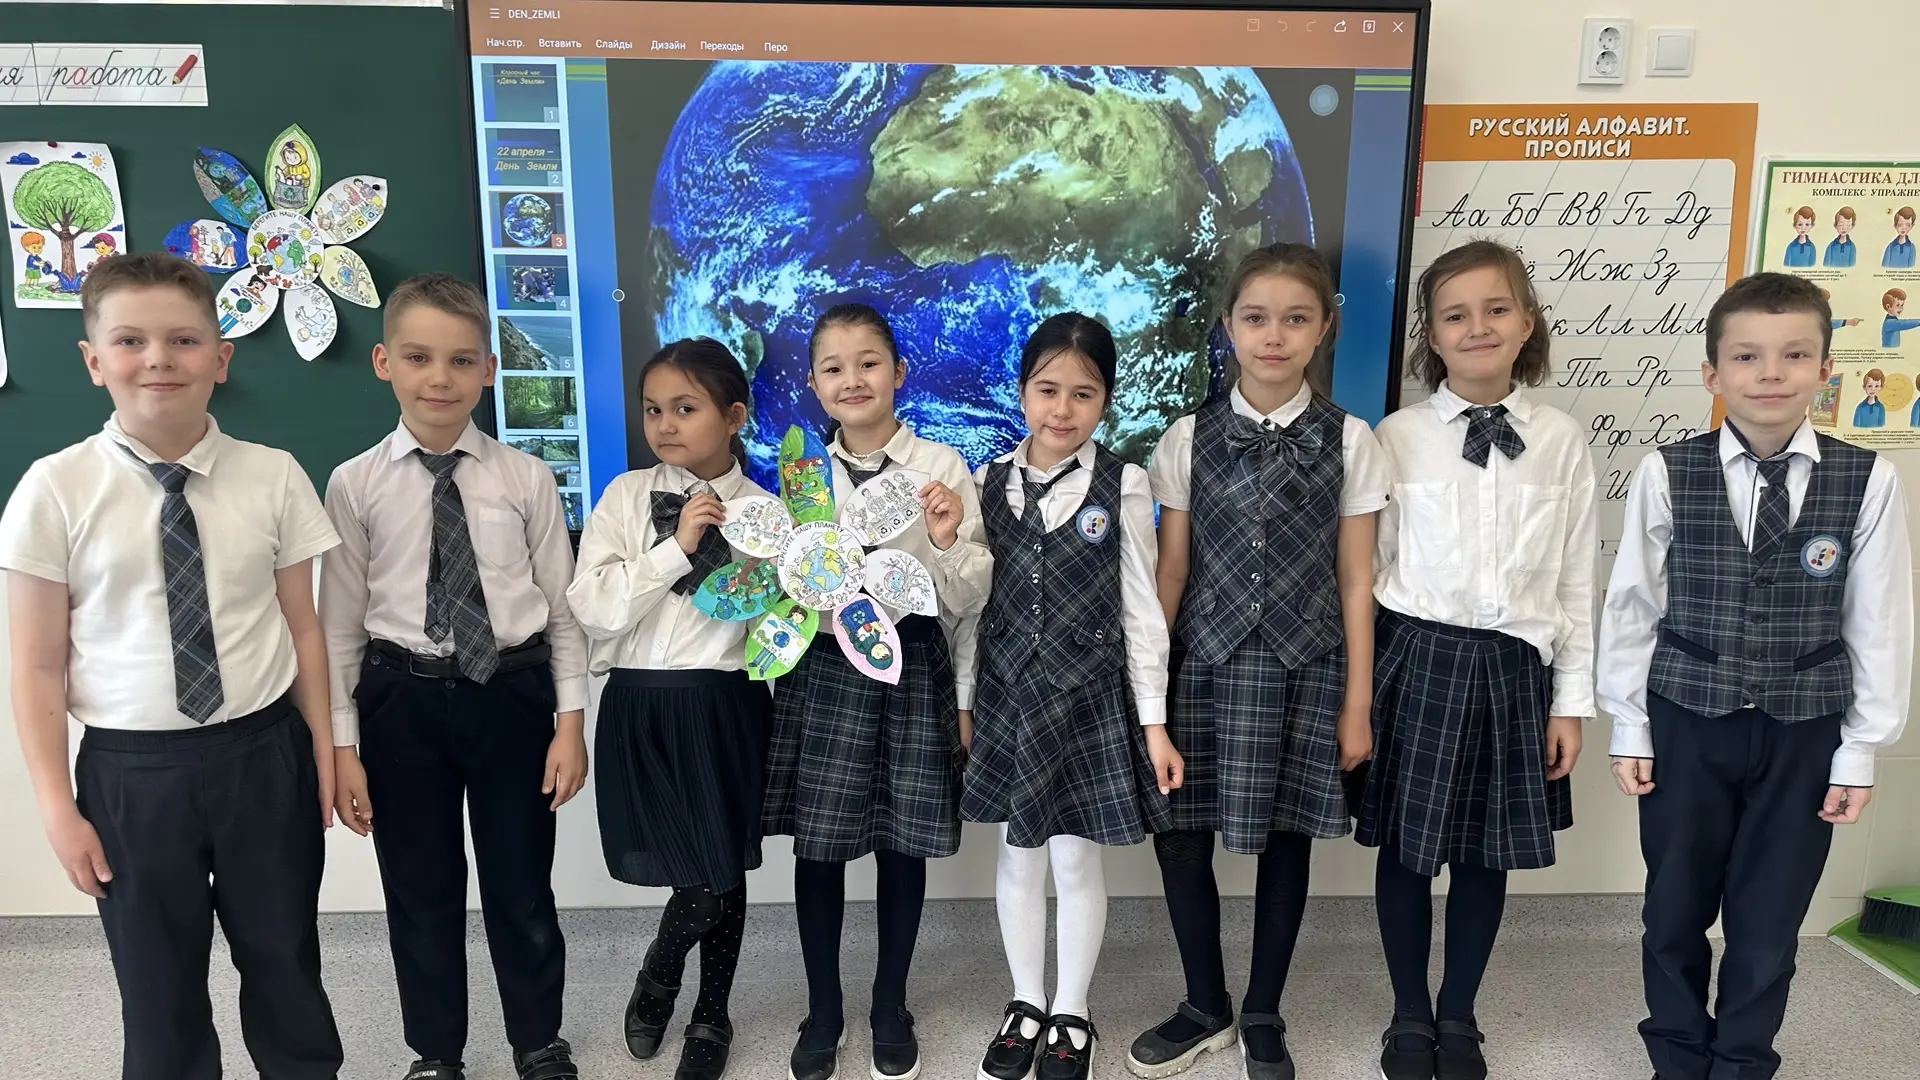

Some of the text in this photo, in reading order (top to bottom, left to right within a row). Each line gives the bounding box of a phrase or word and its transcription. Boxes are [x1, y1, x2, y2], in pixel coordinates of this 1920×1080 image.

[508, 9, 560, 20] DEN_ZEMLI
[486, 38, 525, 49] Нач.стр.
[538, 38, 582, 48] Вставить
[595, 39, 633, 50] Слайды
[651, 40, 686, 51] Дизайн
[700, 41, 744, 52] Переходы
[764, 42, 788, 53] Перо
[46, 50, 167, 101] работа
[1468, 113, 1691, 138] РУССКИЙ АЛФАВИТ.
[497, 147, 509, 156] 22
[511, 148, 545, 158] апреля
[1525, 139, 1632, 158] ПРОПИСИ
[495, 161, 557, 171] День Земли
[552, 174, 559, 184] 2
[1782, 171, 1920, 187] ГИМНАСТИКА ДЛ
[1812, 188, 1867, 197] КОМПЛЕКС
[1432, 190, 1712, 240] Аа Бб Вв Гг Дд
[252, 211, 319, 237] БЕРЕГИТЕ НАШУ ПЛАНЕТУ
[555, 238, 563, 247] 3
[1549, 248, 1634, 281] Жж
[1643, 248, 1681, 296] Зз
[559, 300, 567, 308] 4
[1575, 304, 1634, 335] Лл
[564, 359, 571, 369] 5
[1557, 358, 1612, 387] Пп
[1627, 355, 1672, 398] Рр
[567, 418, 574, 427] 6
[1588, 414, 1631, 459] Фф
[571, 476, 578, 486] 7
[779, 522, 844, 567] БЕРЕГИТЕ НАШУ ПЛАНЕТУ
